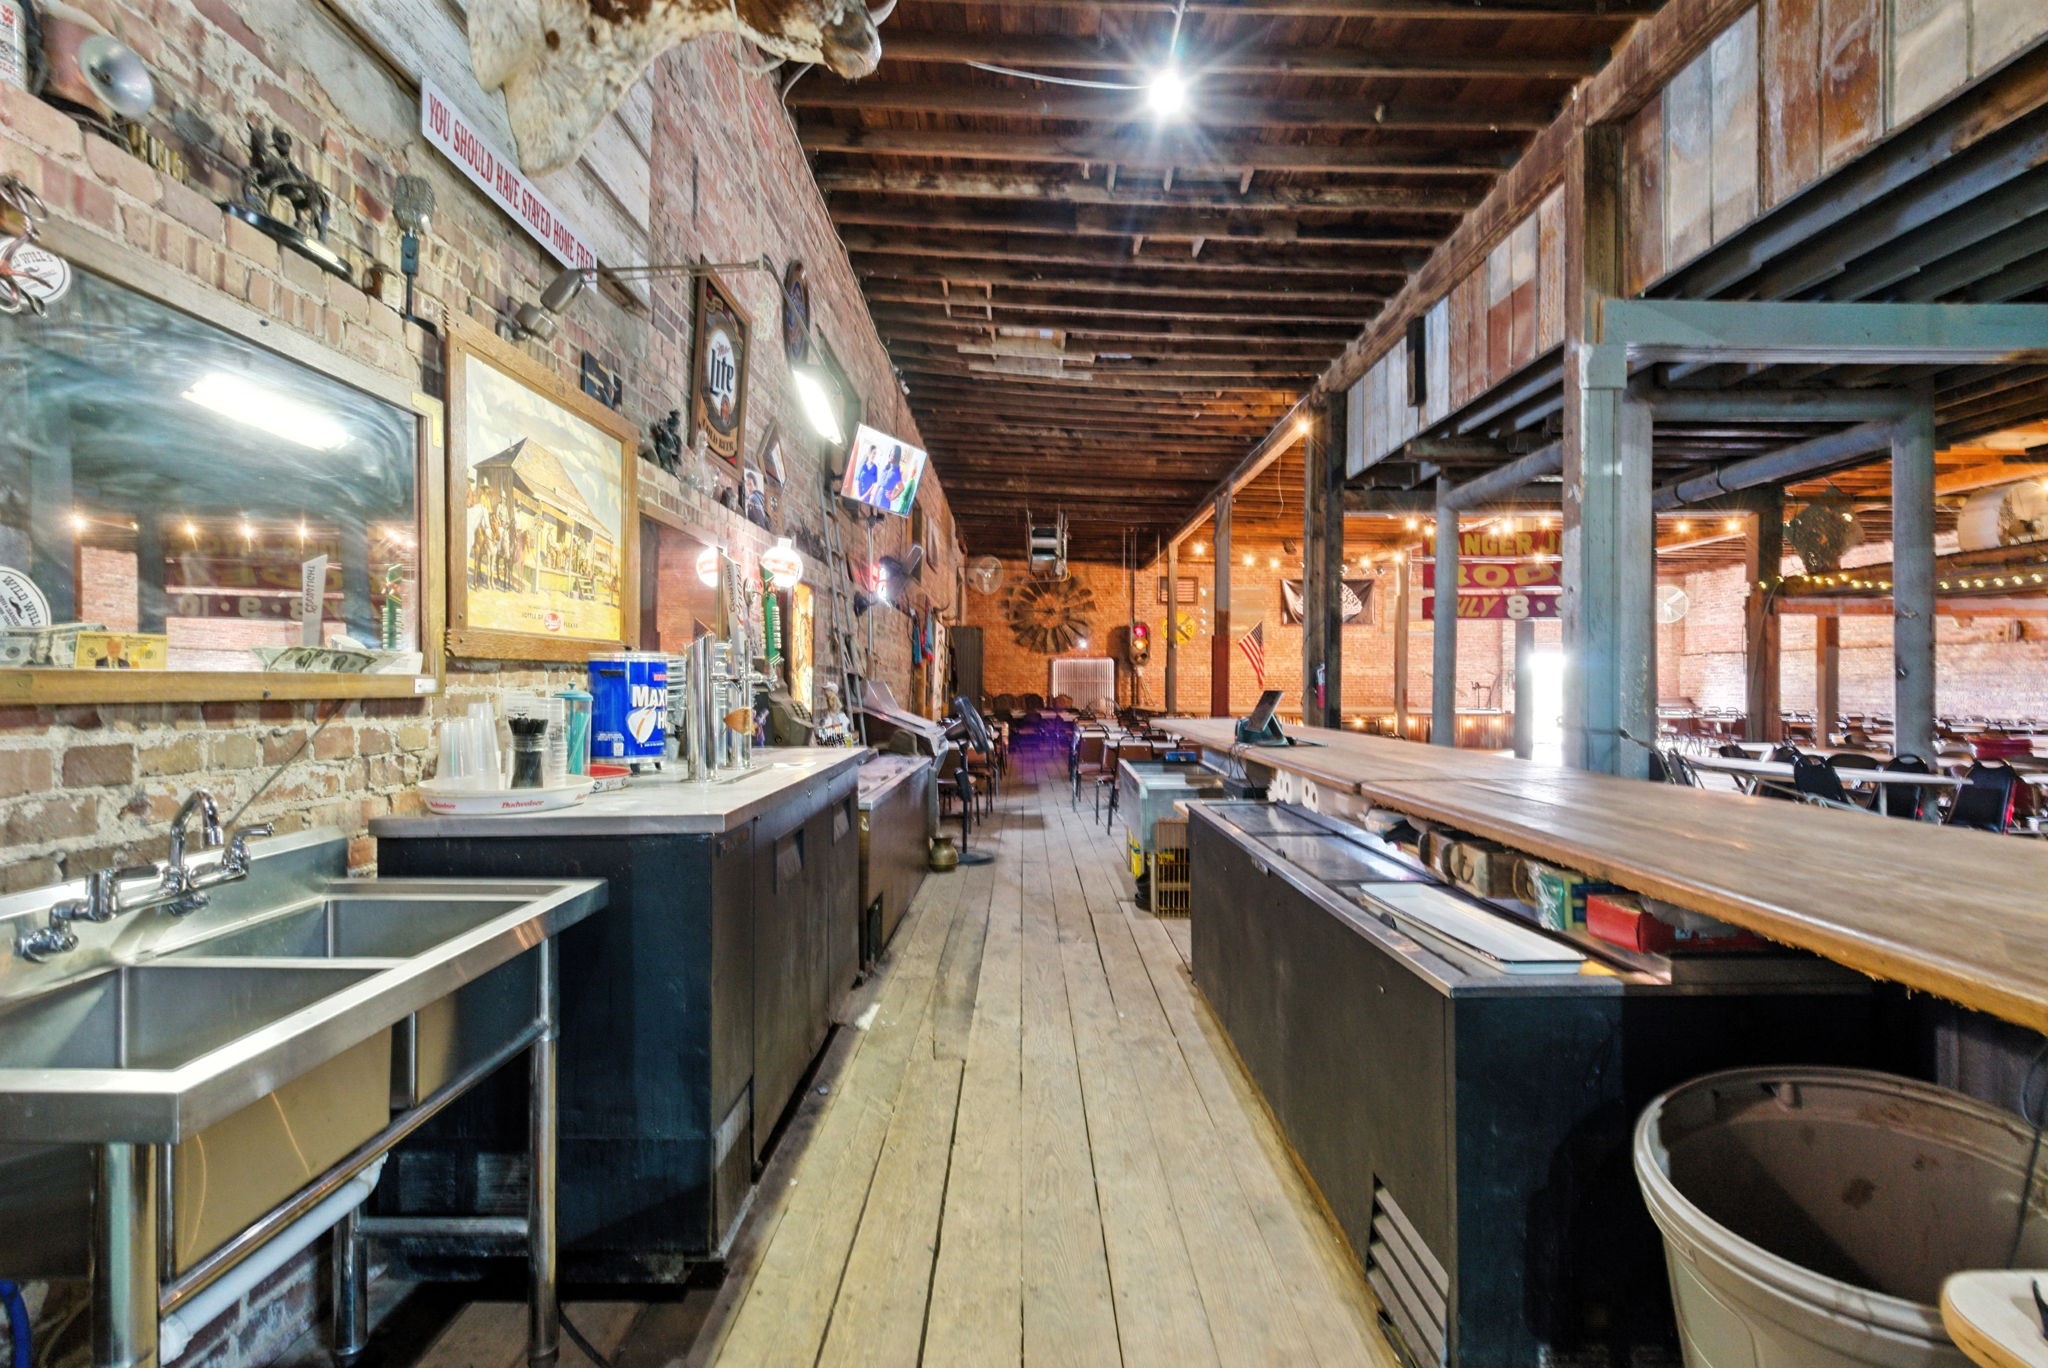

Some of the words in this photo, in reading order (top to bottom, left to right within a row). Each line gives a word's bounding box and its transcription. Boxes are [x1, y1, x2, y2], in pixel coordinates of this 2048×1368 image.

[429, 93, 450, 142] YOU
[453, 120, 493, 184] SHOULD
[495, 162, 520, 210] HAVE
[521, 188, 550, 239] STAYED
[553, 219, 575, 262] HOME
[576, 241, 594, 280] FRED
[709, 348, 734, 397] Lite
[1429, 532, 1533, 556] NGER
[3, 576, 29, 601] WILD
[1431, 596, 1500, 618] ULY
[631, 685, 668, 708] MAX
[501, 800, 545, 809] Budweiser
